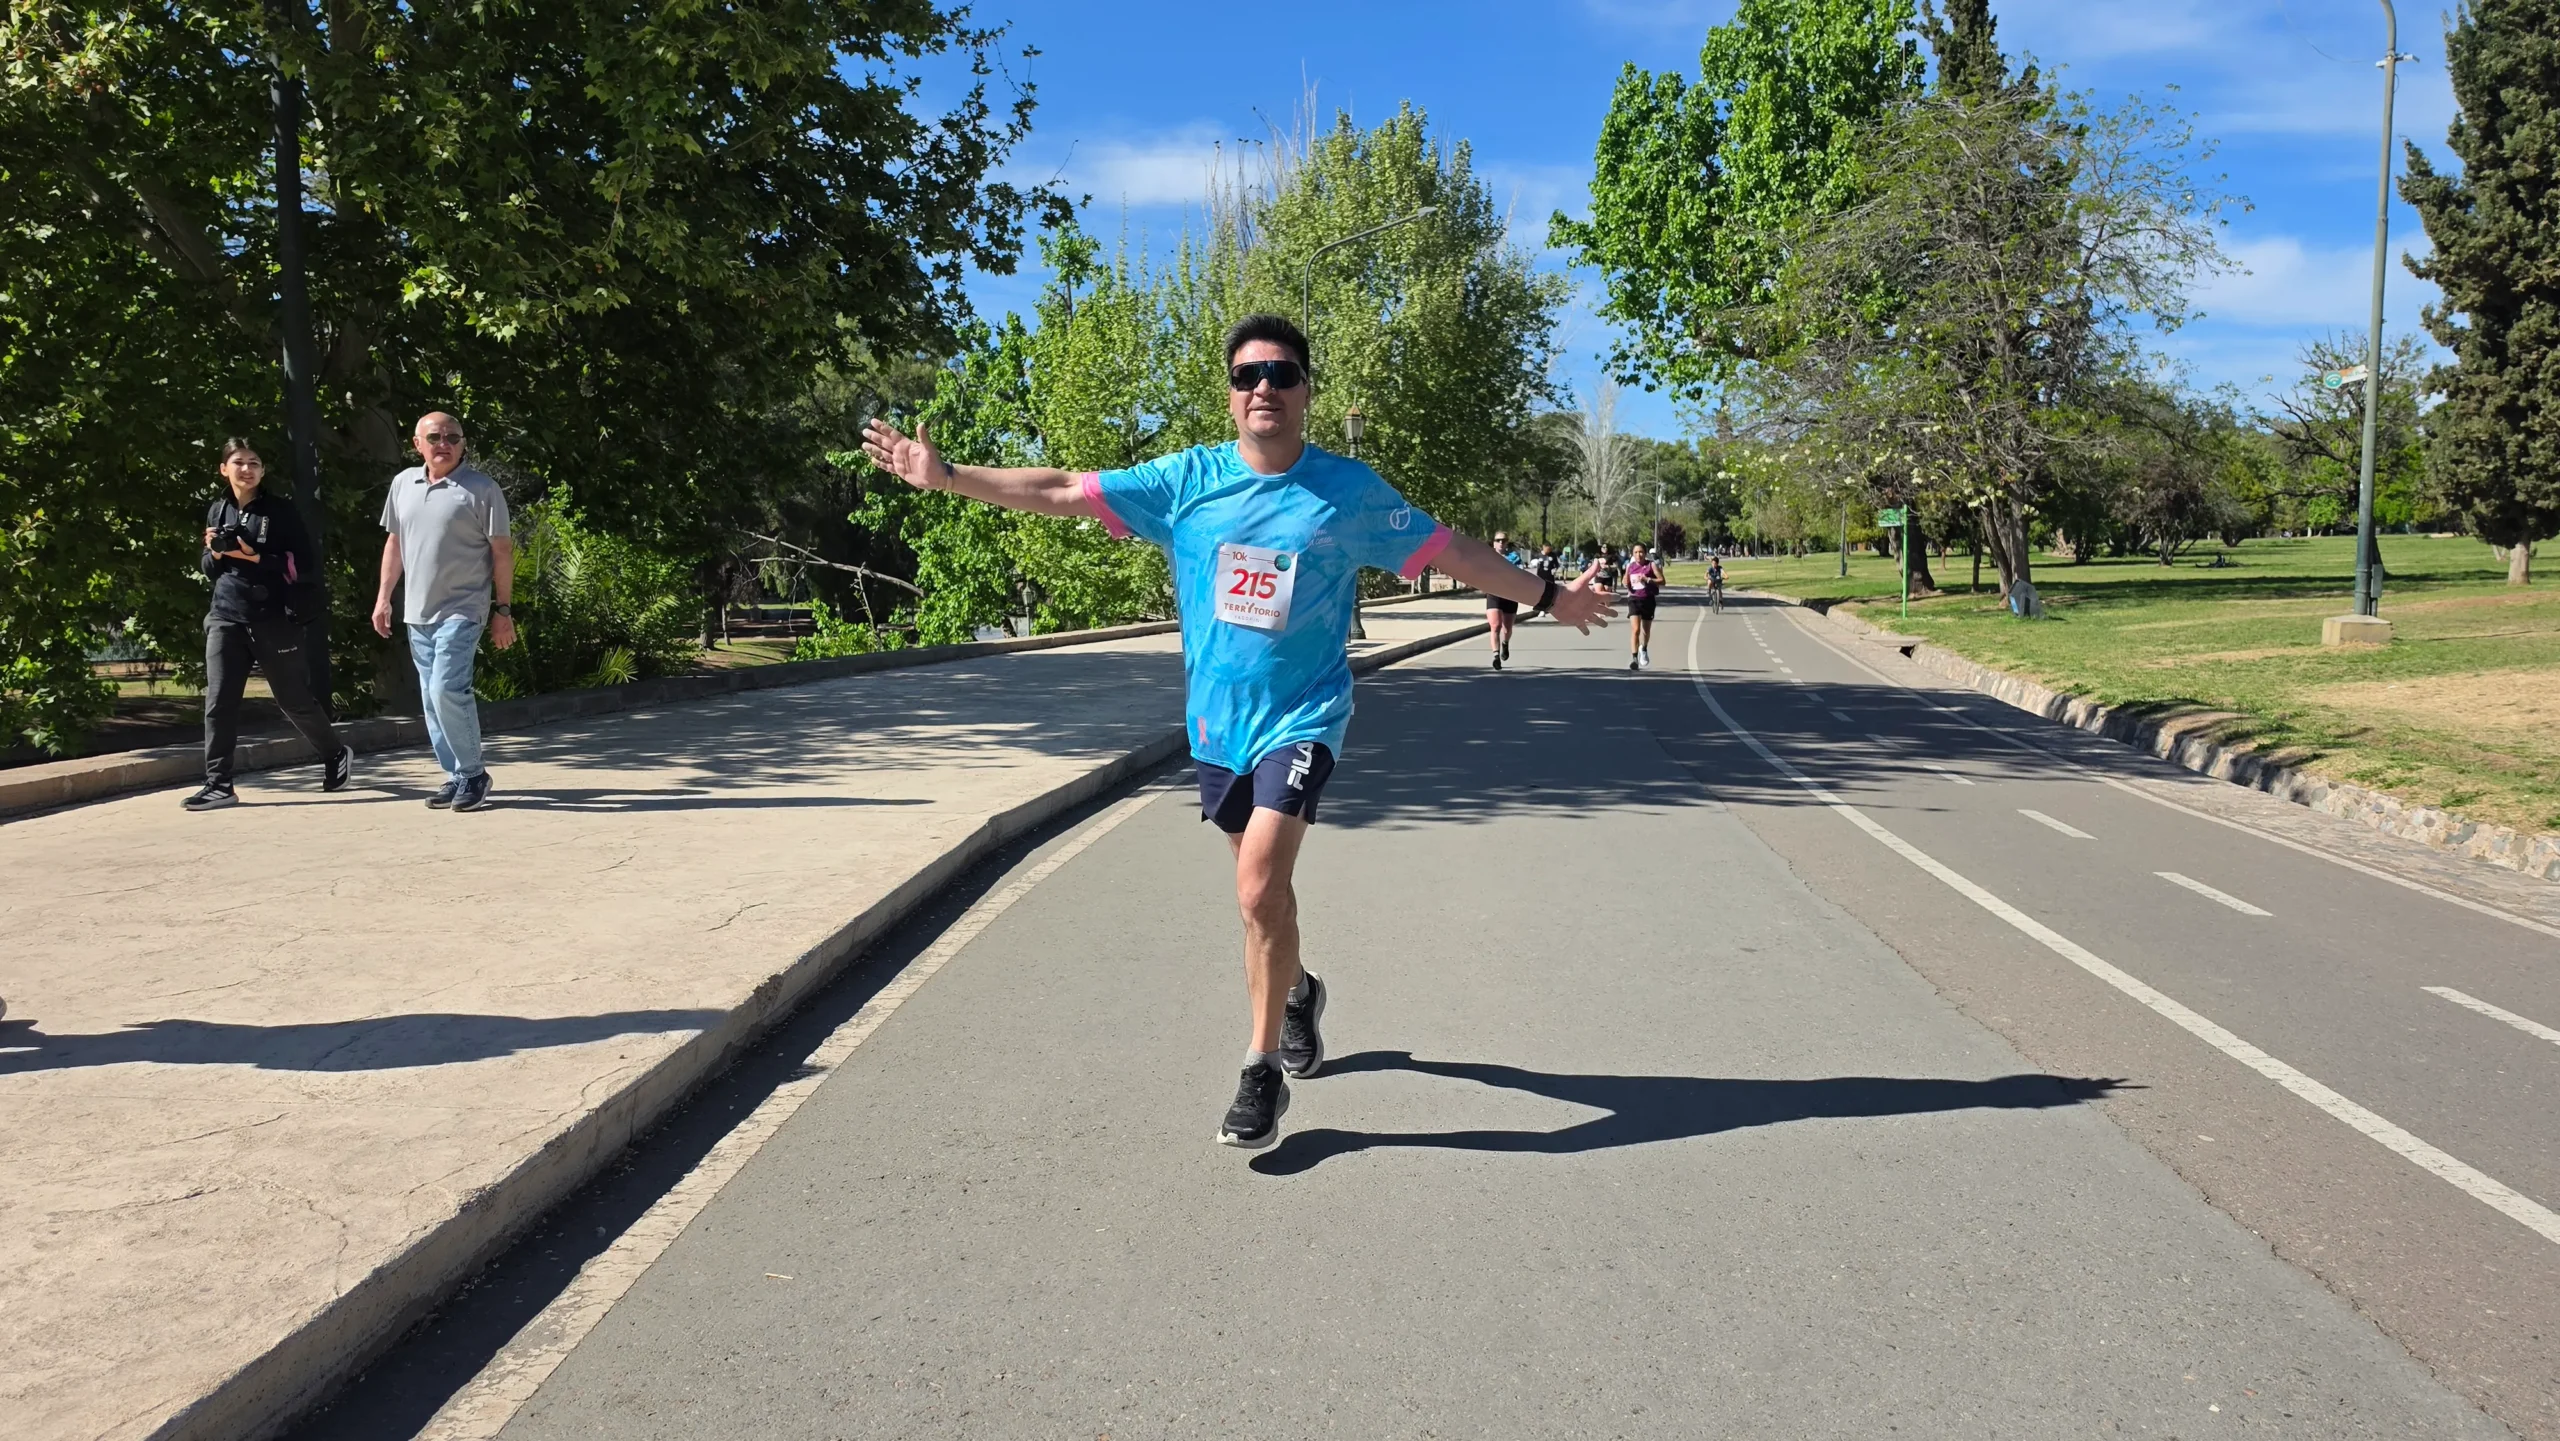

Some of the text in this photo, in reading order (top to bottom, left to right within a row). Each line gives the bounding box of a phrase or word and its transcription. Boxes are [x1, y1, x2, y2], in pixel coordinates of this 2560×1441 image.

[1232, 551, 1247, 562] 10k
[1227, 568, 1278, 599] 215
[1287, 742, 1314, 791] FILA
